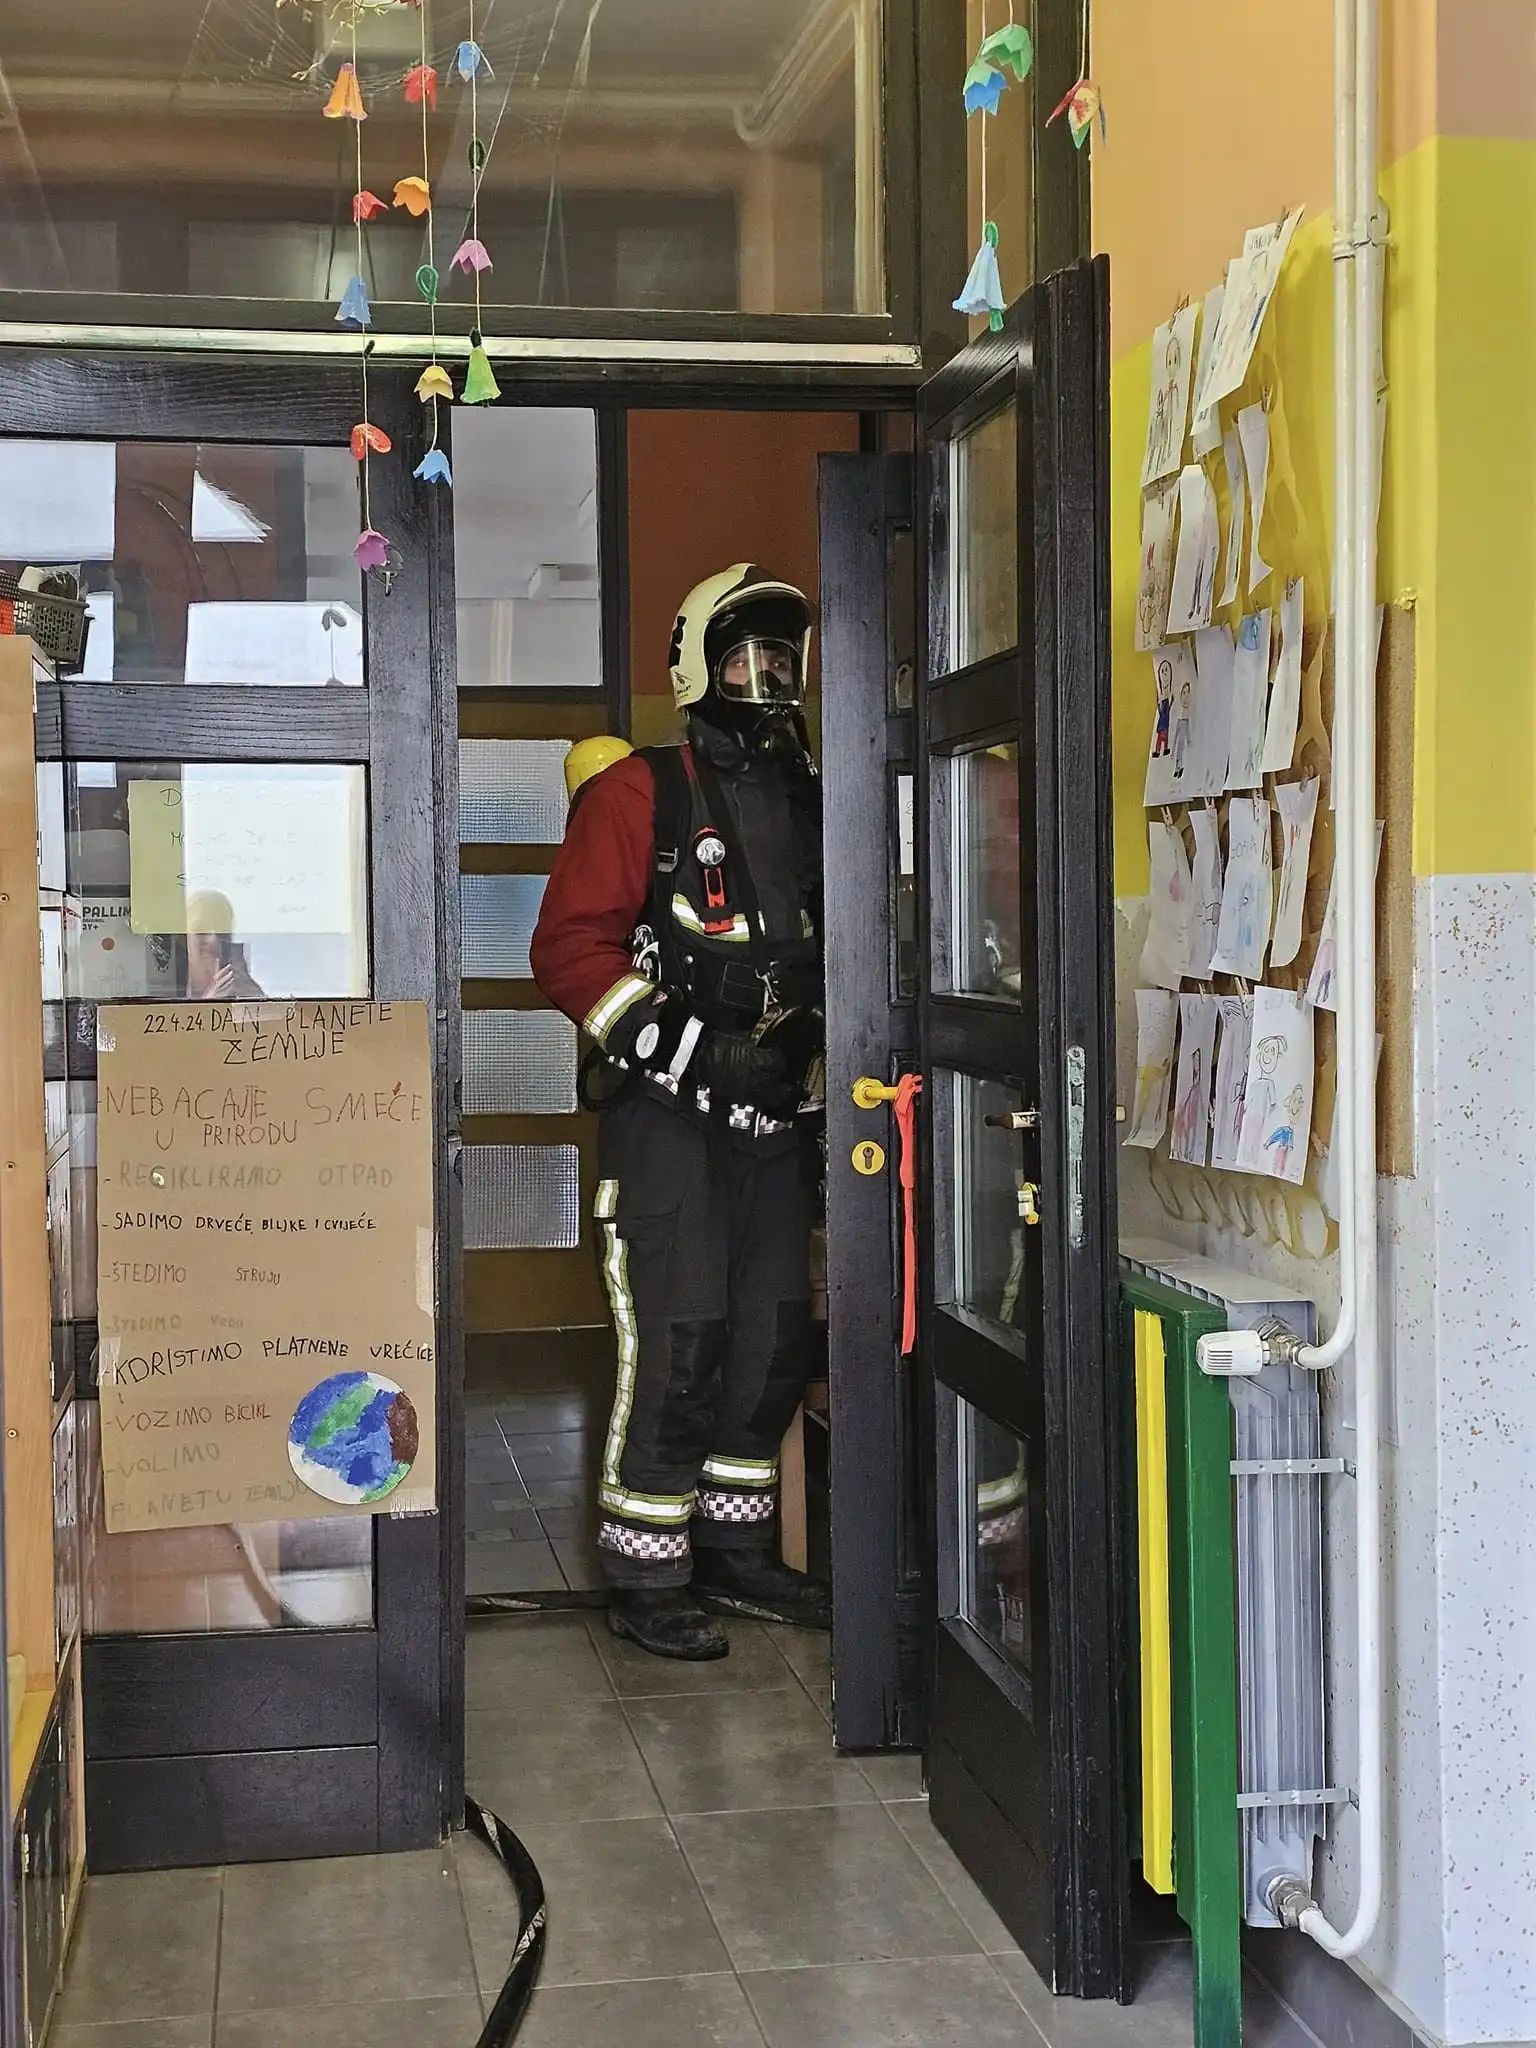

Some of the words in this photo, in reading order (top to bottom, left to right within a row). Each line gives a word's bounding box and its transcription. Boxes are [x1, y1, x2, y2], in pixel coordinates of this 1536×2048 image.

[210, 1007, 263, 1035] DAN
[285, 1001, 393, 1033] PLANETE
[220, 1031, 345, 1065] ZEMLJE
[304, 1081, 424, 1126] SMEĆE
[155, 1127, 175, 1151] U
[203, 1120, 299, 1148] PRIRODU
[317, 1165, 394, 1190] OTPAD
[261, 1217, 308, 1233] BILJKE
[314, 1218, 320, 1230] I
[324, 1211, 378, 1231] CVIJEĆE
[235, 1267, 281, 1286] STRUJU
[262, 1335, 350, 1359] PLATNENE
[370, 1338, 434, 1362] VREĆICE
[224, 1402, 272, 1424] BICIKL
